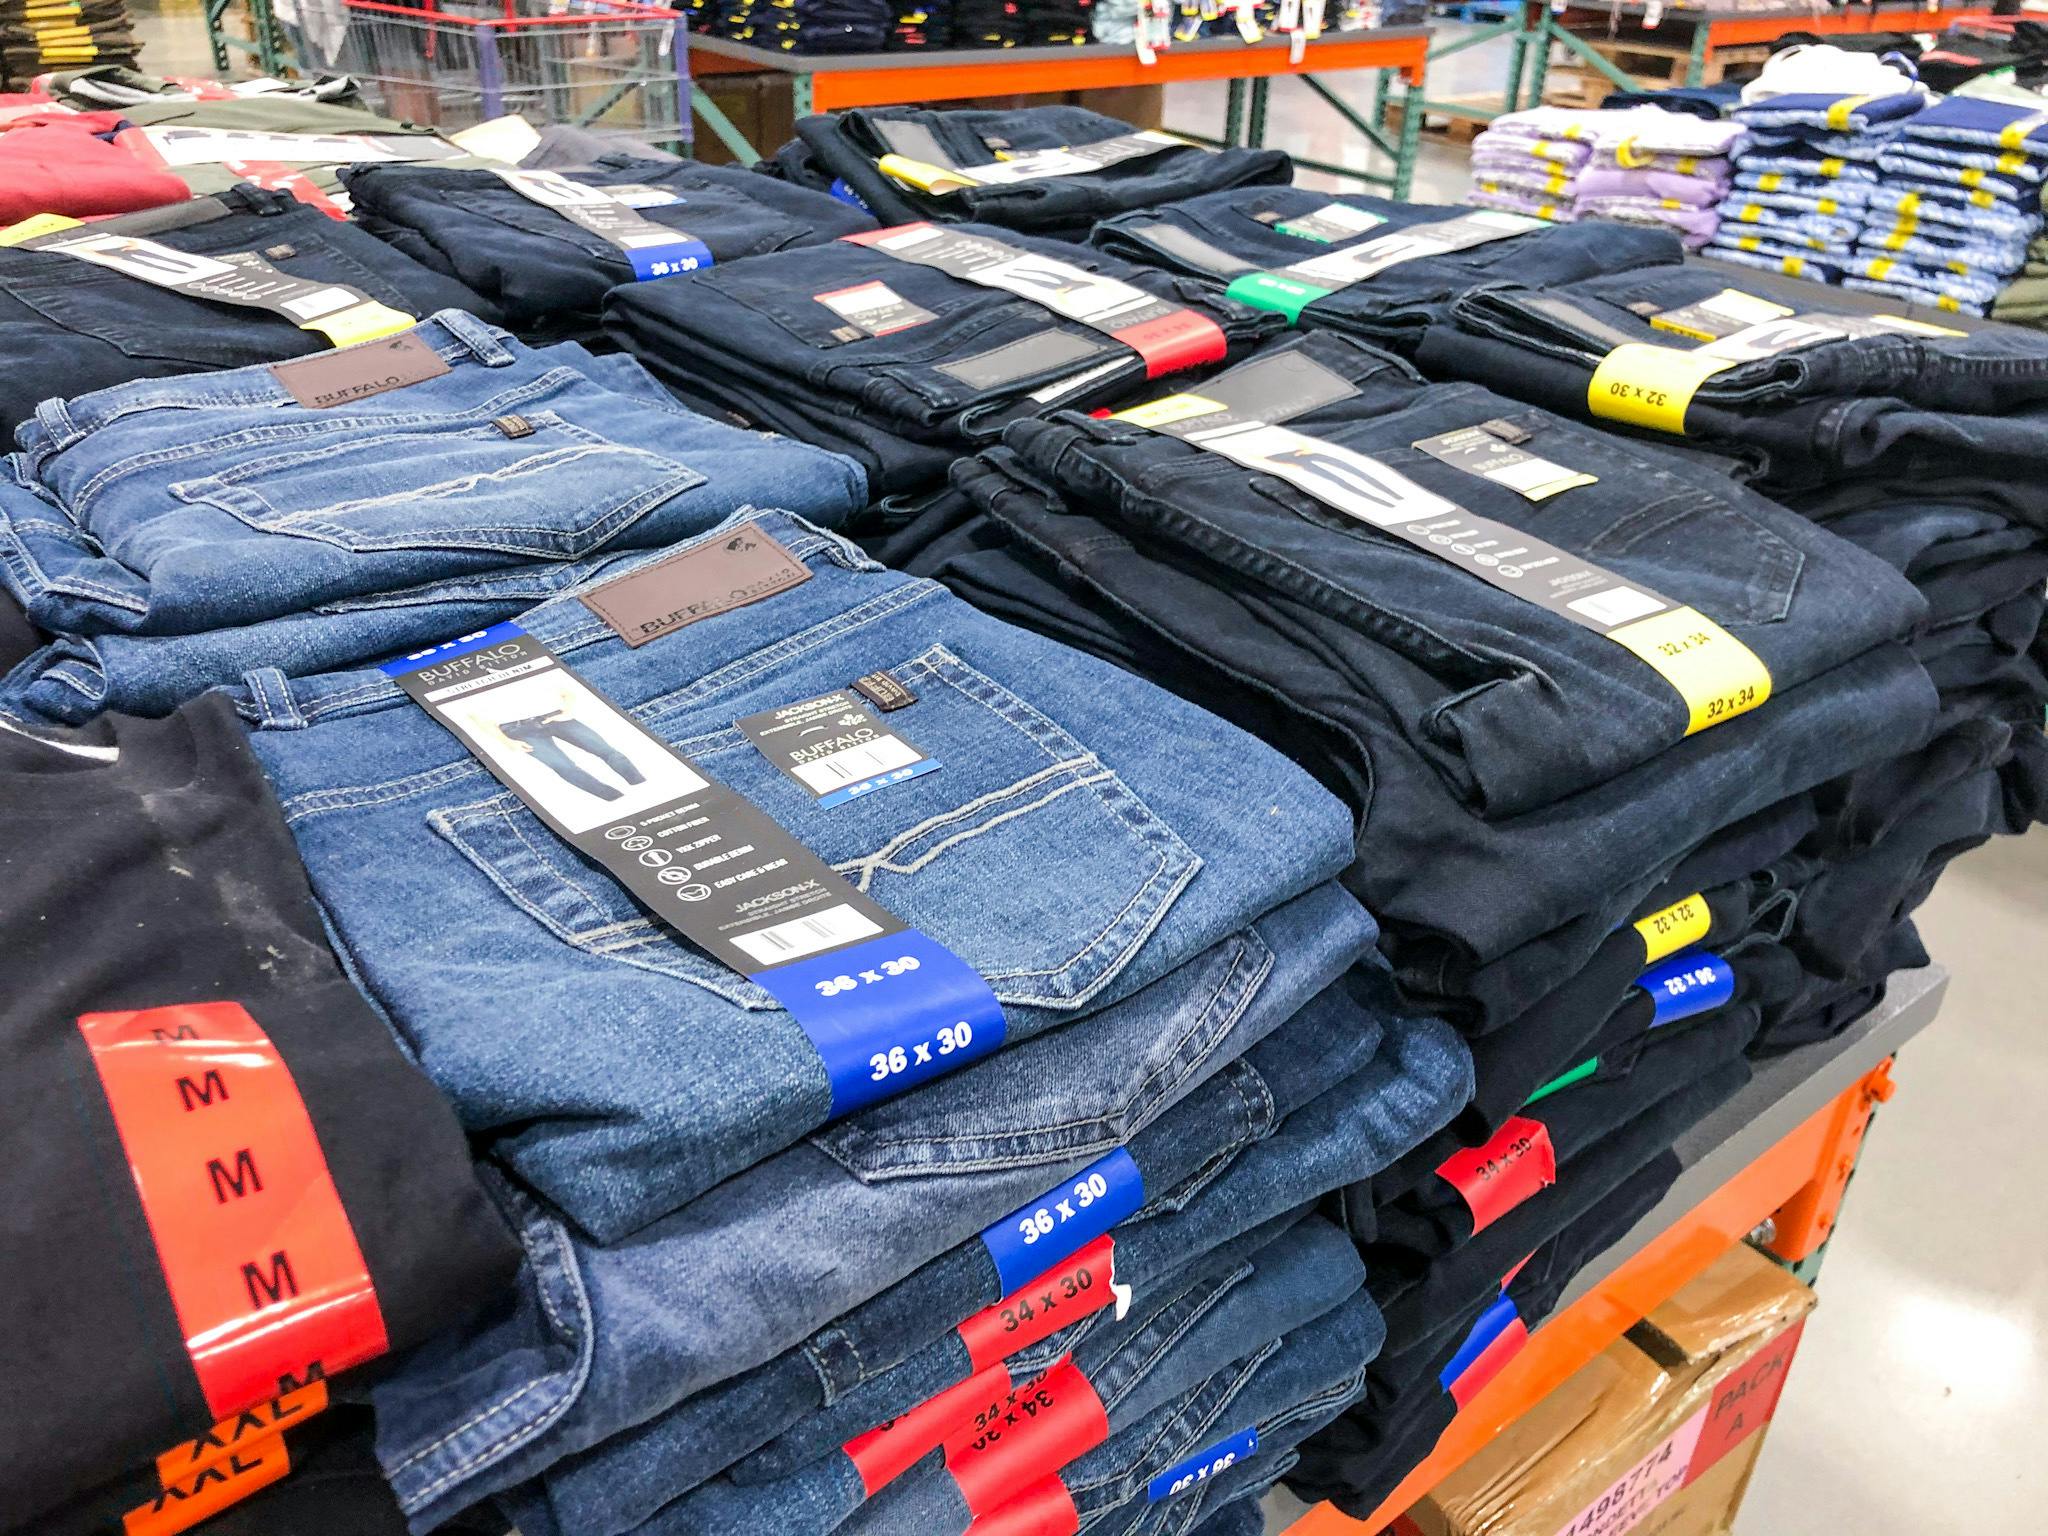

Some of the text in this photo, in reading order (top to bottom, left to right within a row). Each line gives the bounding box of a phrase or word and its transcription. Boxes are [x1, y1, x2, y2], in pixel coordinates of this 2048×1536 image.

[1610, 382, 1667, 406] 32 x 30
[1658, 641, 1682, 656] 32
[1689, 631, 1712, 646] 34
[417, 643, 521, 682] BUFFALO
[775, 693, 845, 720] JACKSON-X
[1707, 685, 1755, 719] 32 x 34
[789, 728, 874, 762] BUFFALO
[735, 878, 820, 913] JACKSON-X
[1677, 904, 1694, 921] 32
[1653, 916, 1671, 934] 32
[815, 956, 921, 997] 36 x 30
[869, 1021, 973, 1081] 36 x 30
[176, 1069, 229, 1112] M
[207, 1149, 264, 1204] M
[1475, 1137, 1532, 1181] 34 x 30
[1018, 1173, 1107, 1245] 36 x 30
[241, 1250, 299, 1309] M
[1000, 1268, 1092, 1332] 34 x 30
[1715, 1347, 1788, 1420] PACK
[973, 1403, 1001, 1433] 34
[1022, 1389, 1053, 1417] 34
[1726, 1412, 1744, 1440] A
